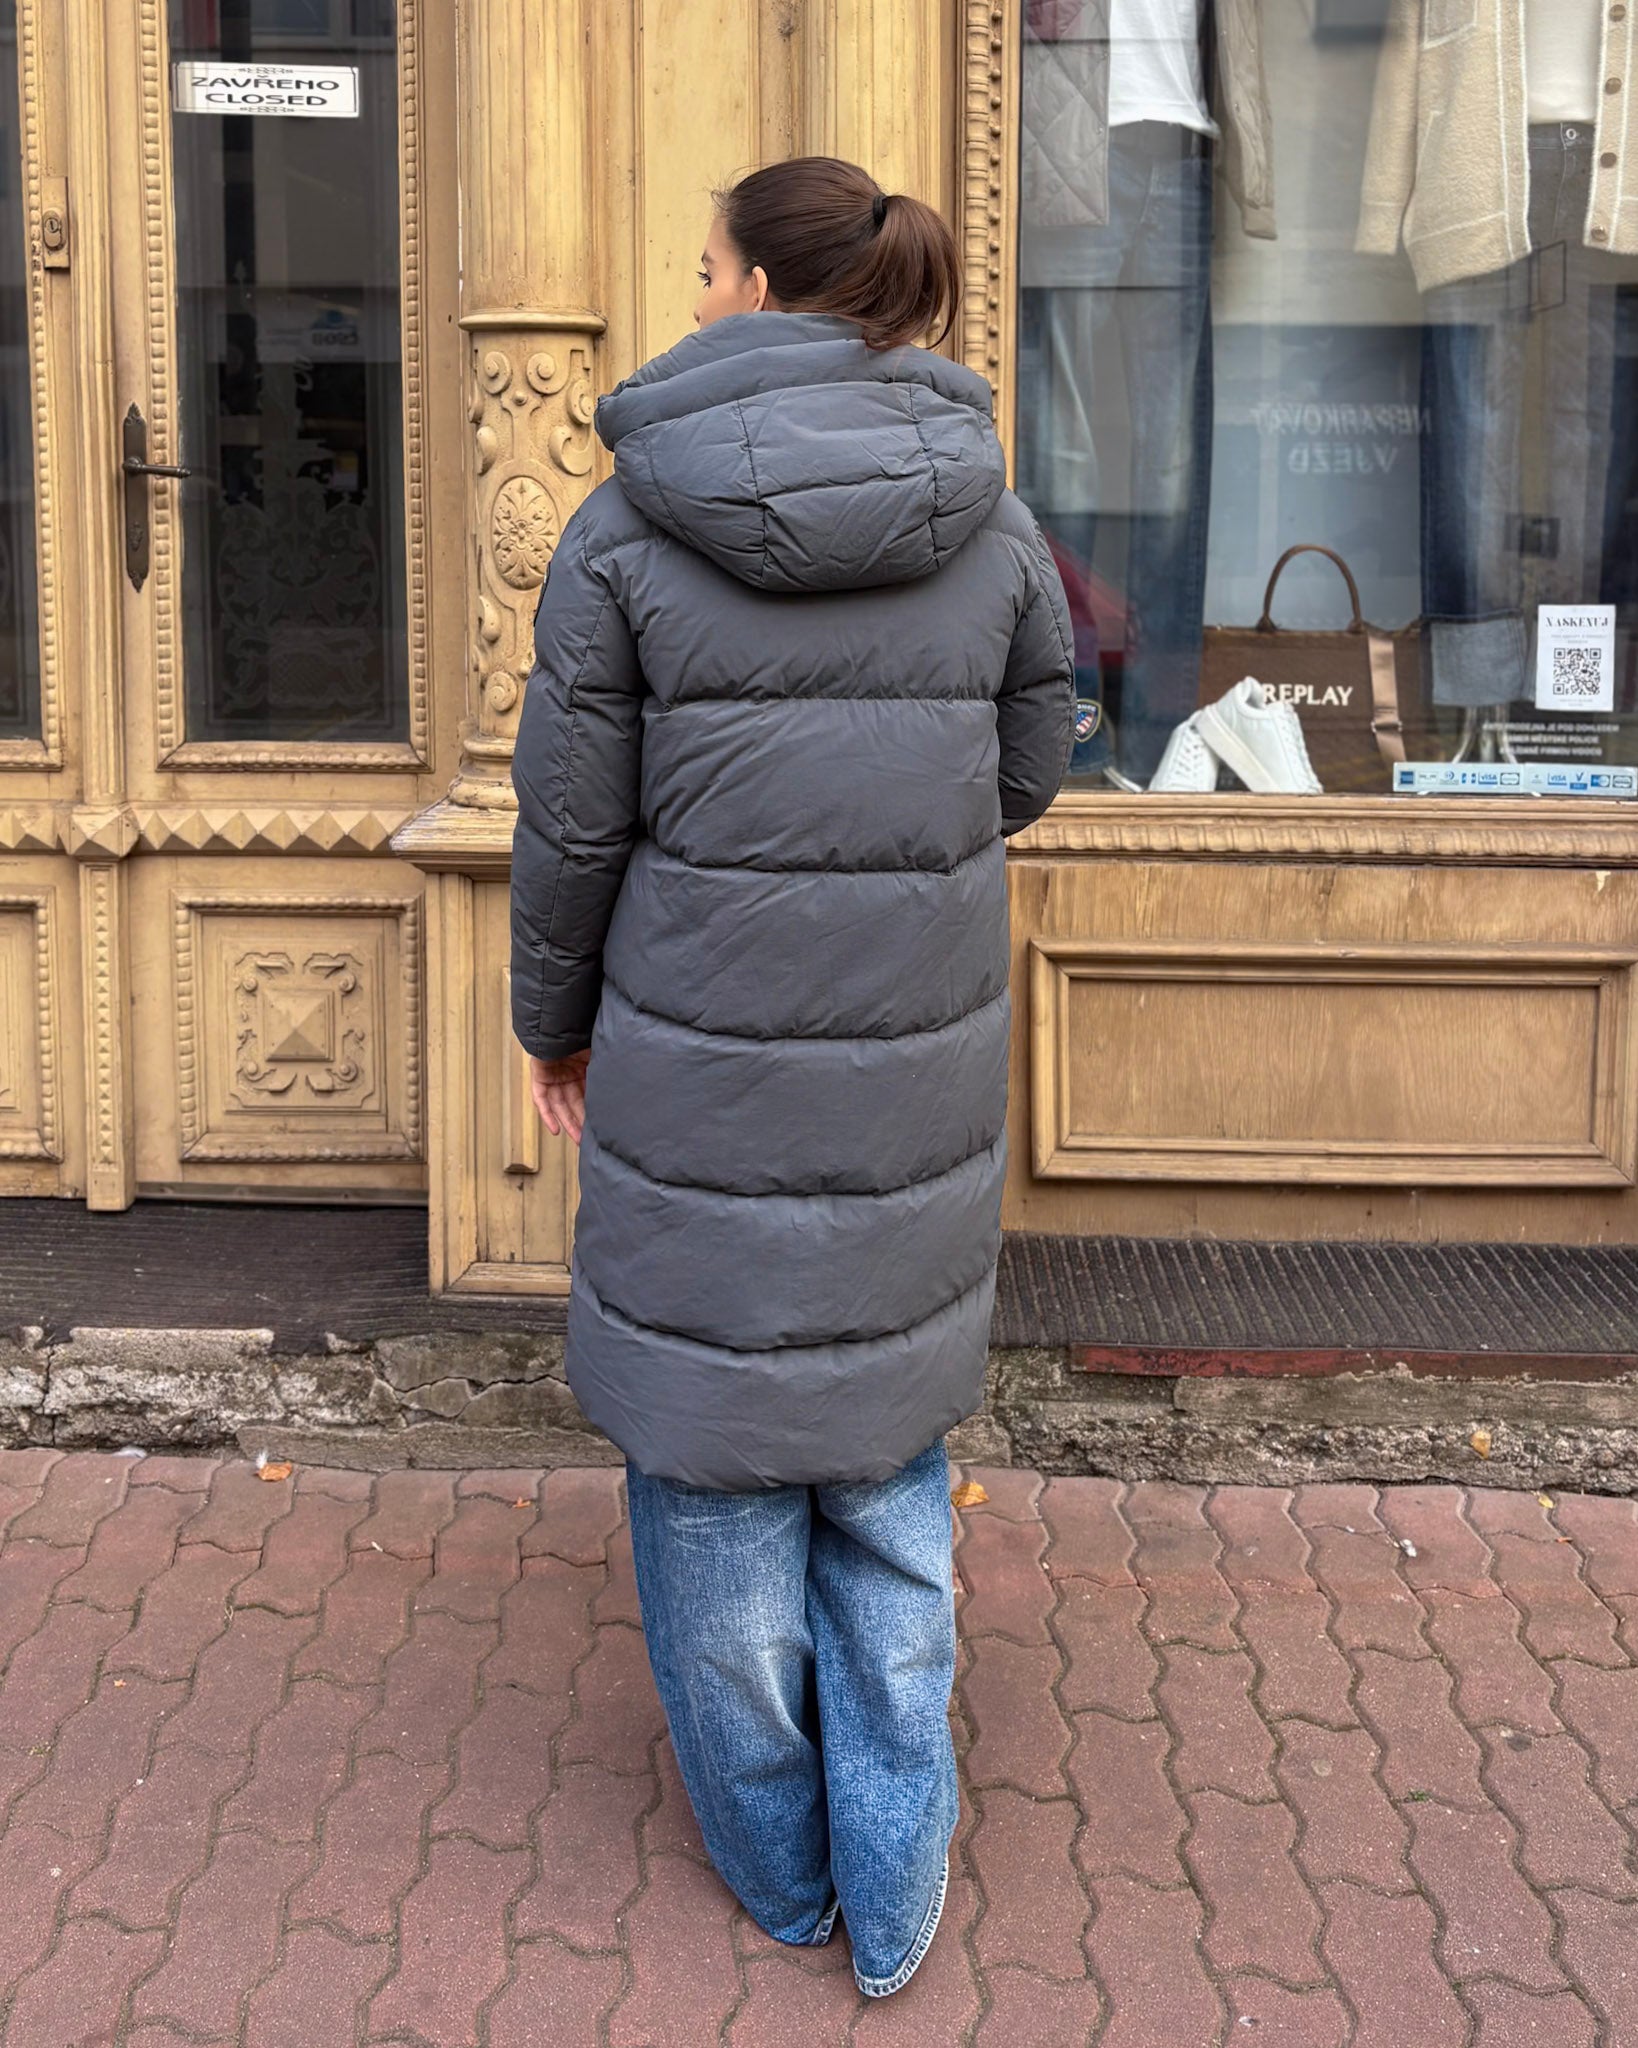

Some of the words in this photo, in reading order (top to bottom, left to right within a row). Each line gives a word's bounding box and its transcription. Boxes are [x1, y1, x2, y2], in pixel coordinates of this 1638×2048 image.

[191, 74, 339, 91] ZAVŘENO
[205, 93, 328, 106] CLOSED
[1262, 683, 1353, 706] REPLAY
